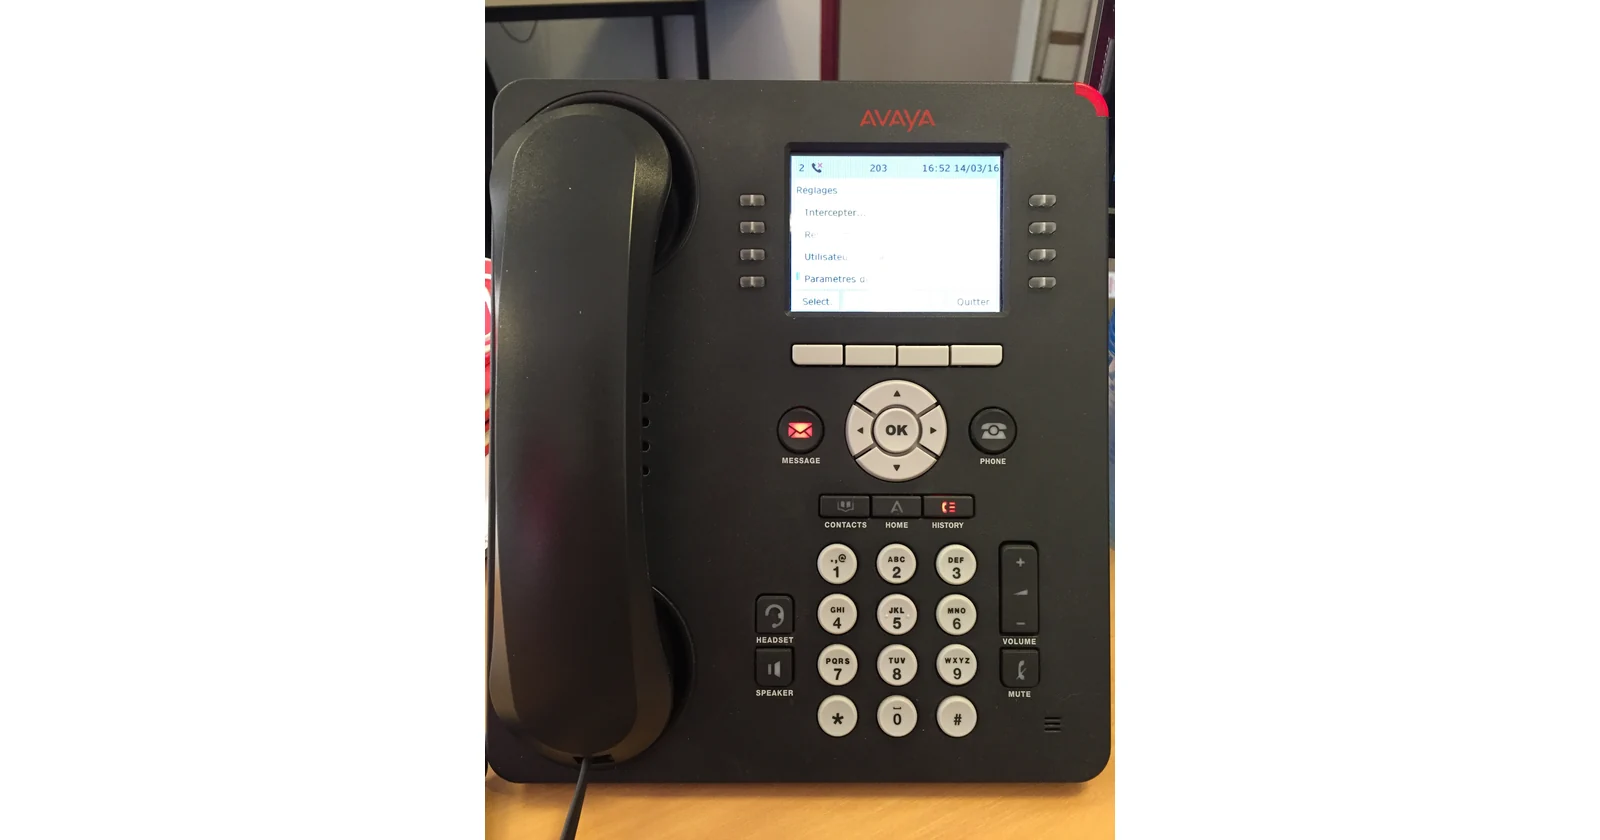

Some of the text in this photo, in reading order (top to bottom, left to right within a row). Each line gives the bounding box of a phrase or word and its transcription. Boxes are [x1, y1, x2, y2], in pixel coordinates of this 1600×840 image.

[859, 109, 936, 132] AVAYA
[798, 164, 999, 173] 2 203 16:52 14/03/16
[957, 297, 990, 307] Quitter
[885, 424, 909, 436] OK
[781, 456, 821, 465] MESSAGE
[979, 457, 1007, 465] PHONE
[824, 521, 868, 529] CONTACTS
[885, 521, 909, 529] HOME
[931, 521, 964, 529] HISTORY
[887, 555, 906, 563] ABC
[947, 556, 965, 564] DEF
[832, 565, 840, 579] 1
[892, 565, 902, 579] 2
[952, 566, 962, 580] 3
[830, 606, 845, 614] GHI
[888, 606, 905, 614] JKL
[947, 607, 967, 615] MNO
[832, 616, 842, 630] 4
[892, 616, 902, 630] 5
[952, 617, 962, 630] 6
[756, 636, 794, 644] HEADSET
[1002, 637, 1037, 646] VOLUME
[825, 657, 851, 665] PQRS
[888, 657, 906, 665] TUV
[944, 657, 971, 665] WXYZ
[833, 667, 843, 681] 7
[892, 667, 902, 681] 8
[952, 667, 962, 680] 9
[755, 689, 794, 697] SPEAKER
[1007, 690, 1032, 698] MUTE
[892, 713, 902, 726] 0
